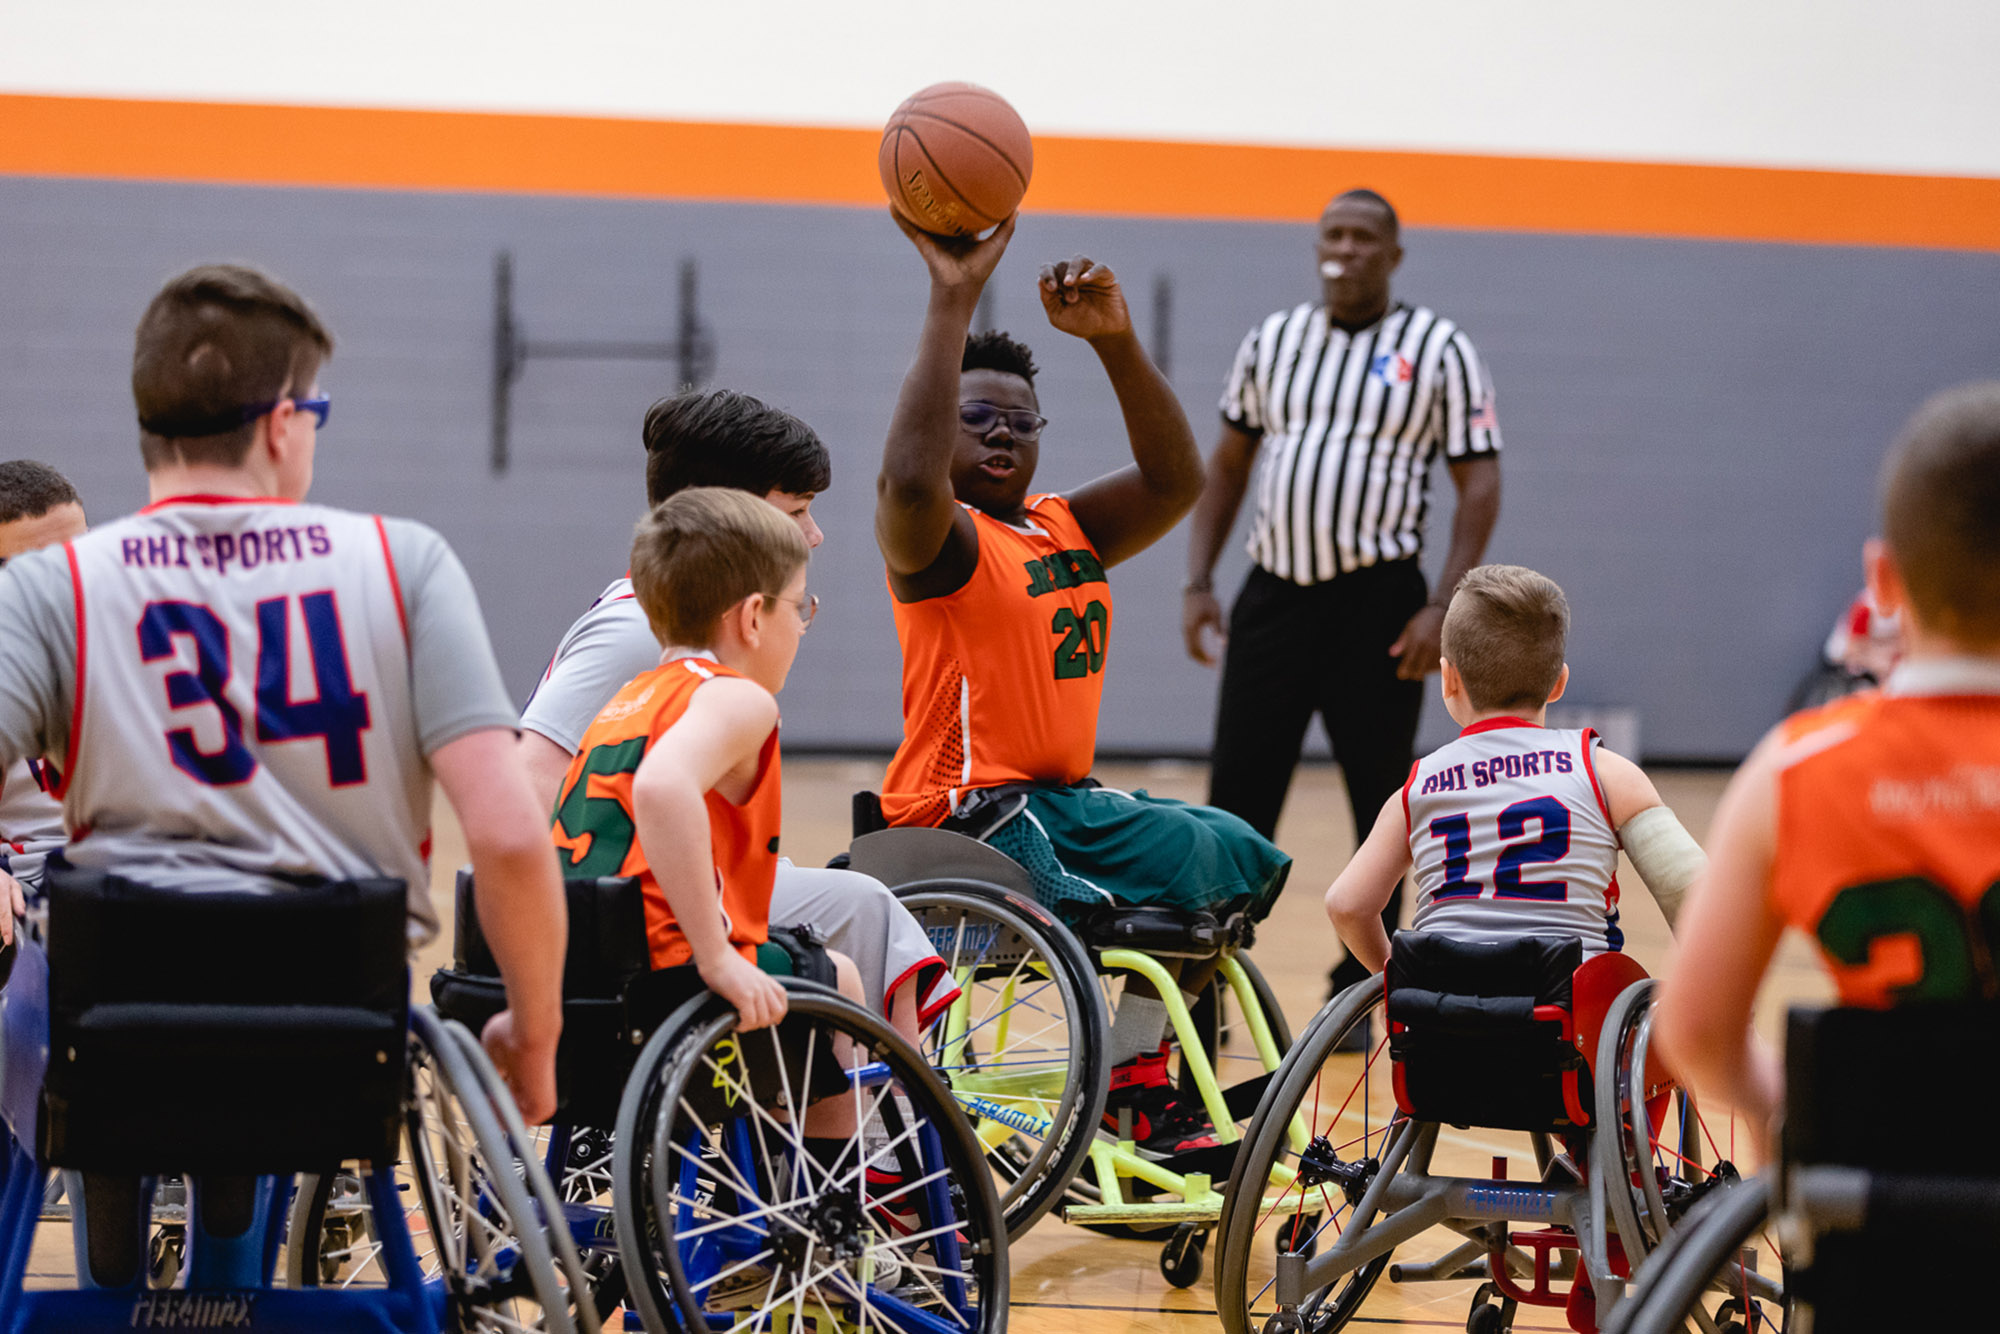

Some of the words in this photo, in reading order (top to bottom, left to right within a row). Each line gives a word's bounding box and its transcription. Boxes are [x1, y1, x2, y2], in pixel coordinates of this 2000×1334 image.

[121, 534, 190, 570] RHI
[195, 524, 333, 577] SPORTS
[1052, 599, 1107, 680] 20
[137, 589, 371, 790] 34
[1420, 763, 1468, 796] RHI
[1472, 750, 1574, 788] SPORTS
[1428, 795, 1572, 906] 12
